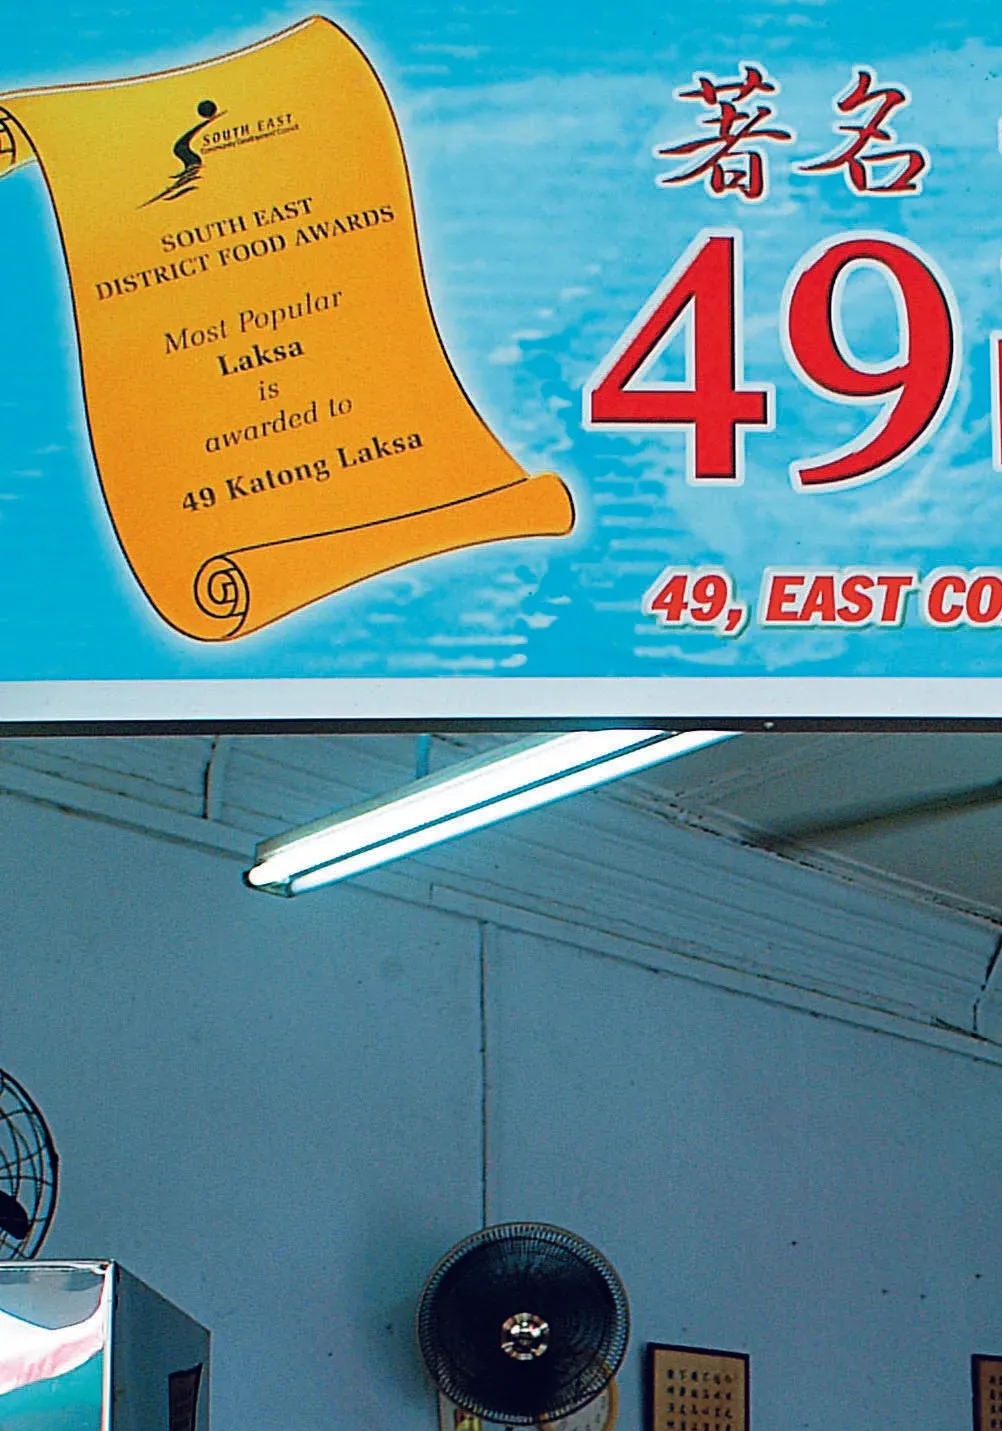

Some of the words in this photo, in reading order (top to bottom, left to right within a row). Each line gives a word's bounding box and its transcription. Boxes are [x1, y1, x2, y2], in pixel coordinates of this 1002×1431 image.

[203, 124, 250, 146] SOUTH
[257, 114, 292, 131] EAST
[658, 67, 926, 199] 著名
[95, 254, 209, 300] DISTRICT
[217, 234, 286, 267] FOOD
[295, 204, 395, 247] AWARDS
[161, 215, 247, 254] SOUTH
[252, 197, 313, 229] EAST
[164, 319, 228, 354] Most
[239, 290, 343, 334] Popular
[217, 340, 305, 377] Laksa
[589, 235, 955, 486] 49
[259, 380, 280, 401] is
[205, 401, 318, 453] awarded
[329, 398, 353, 418] to
[182, 487, 216, 512] 49
[225, 458, 331, 500] Katong
[336, 433, 424, 468] Laksa
[652, 574, 747, 633] 49,
[765, 574, 912, 624] EAST
